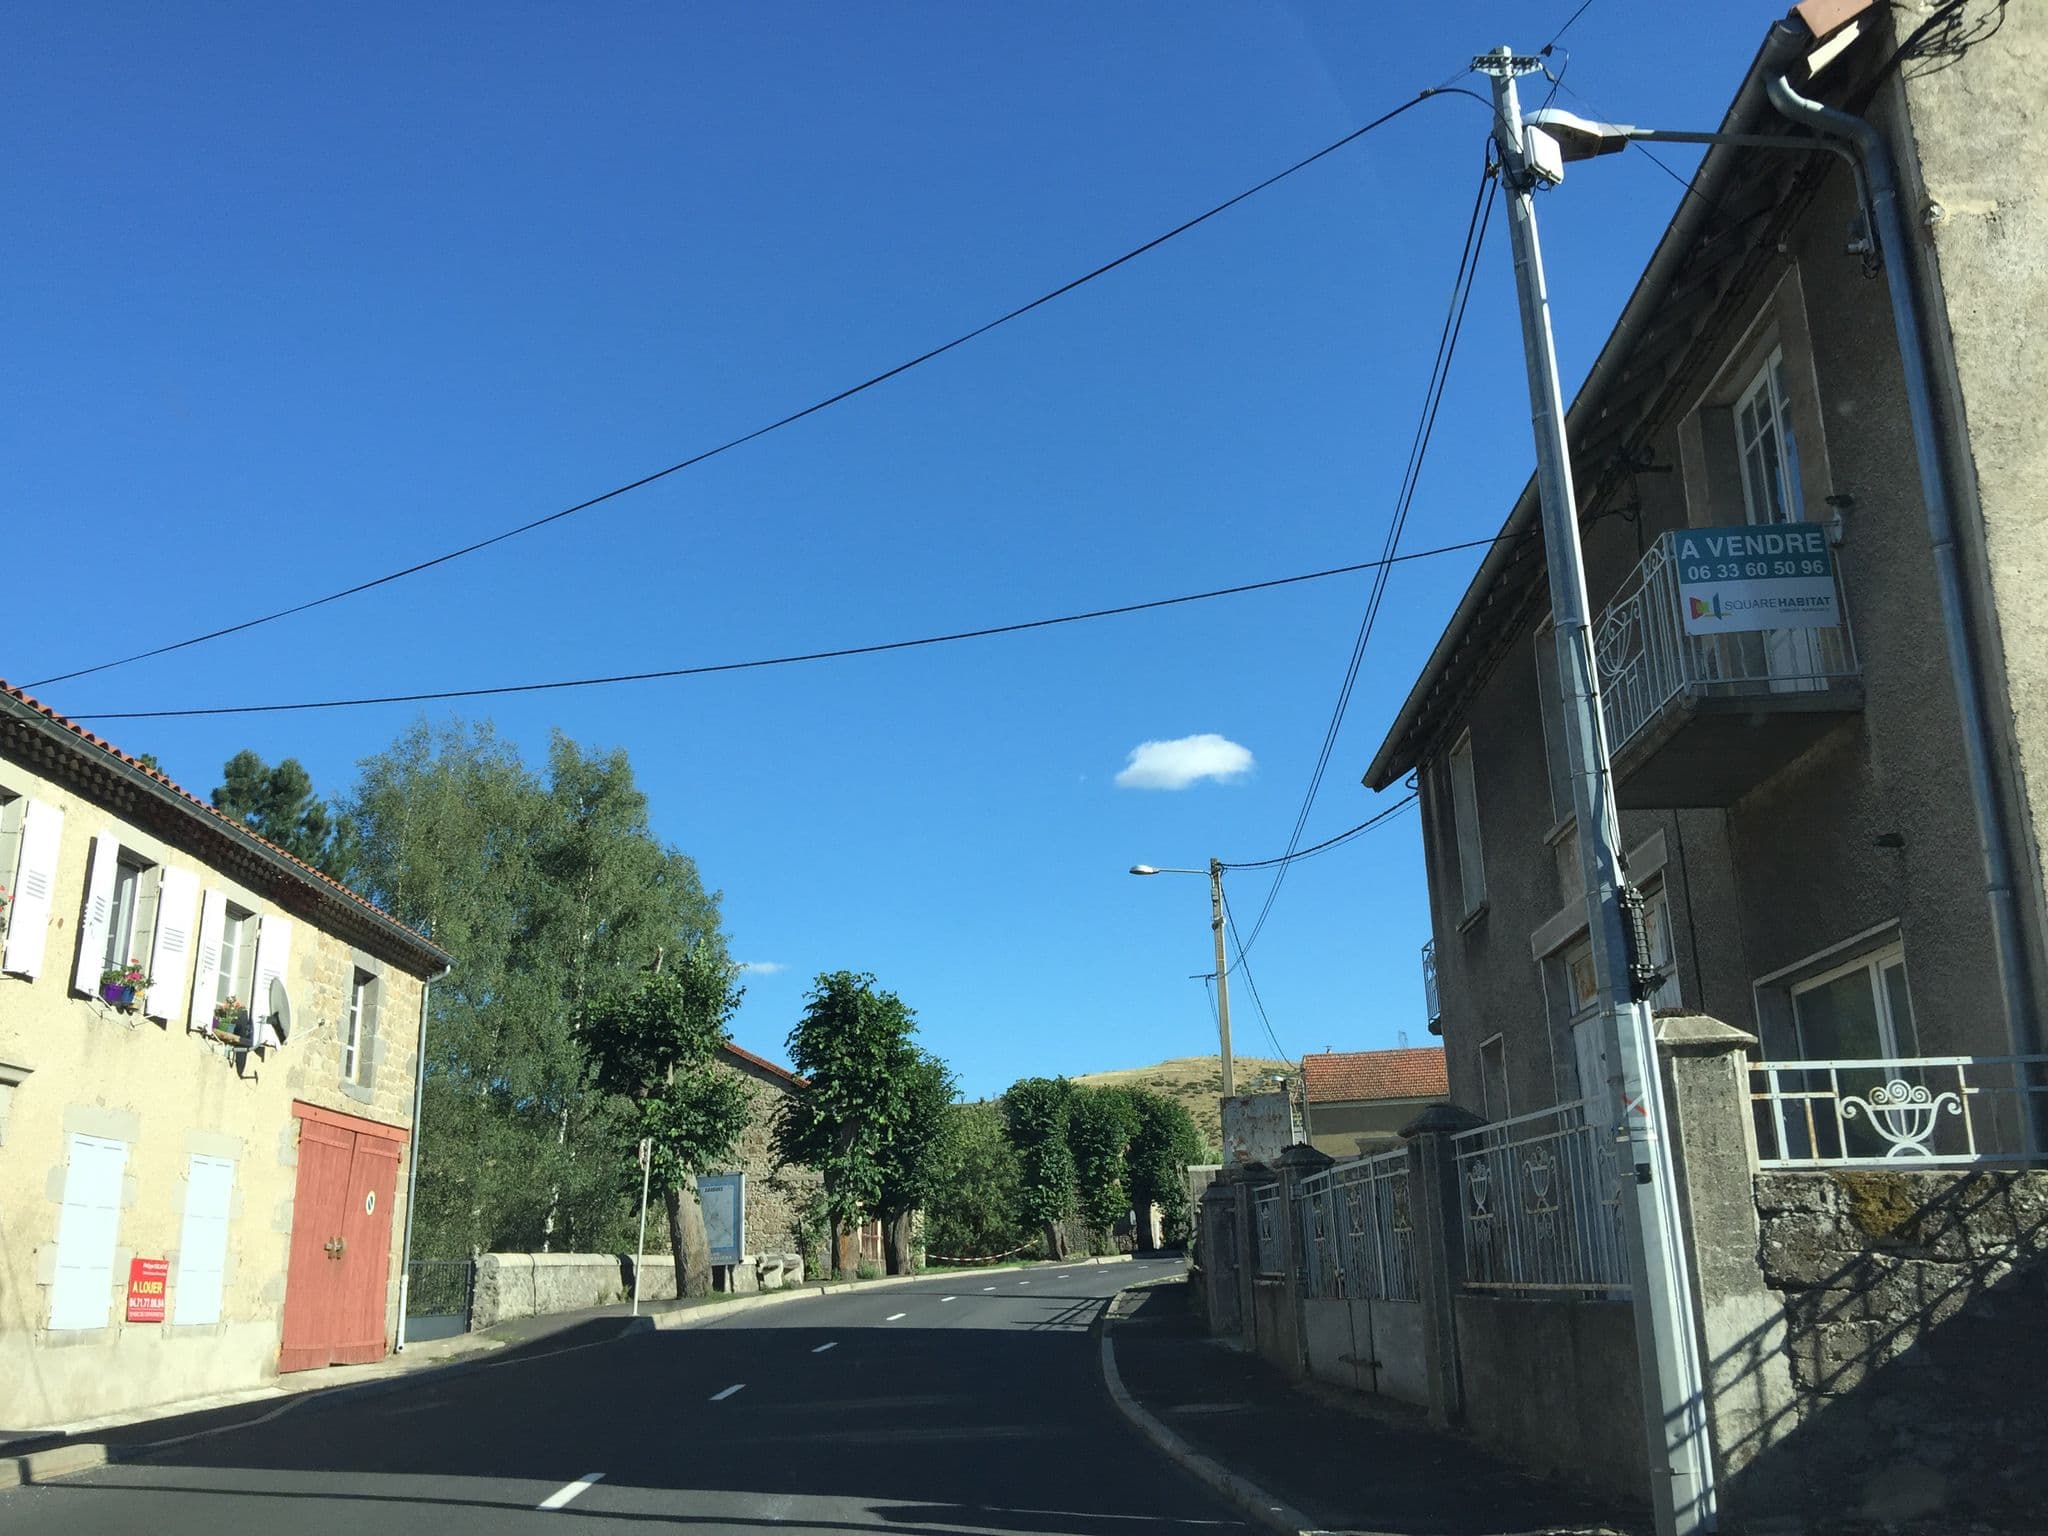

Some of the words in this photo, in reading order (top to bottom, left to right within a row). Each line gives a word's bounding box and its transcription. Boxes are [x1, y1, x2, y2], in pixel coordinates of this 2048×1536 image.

[1681, 539, 1700, 559] A
[1705, 533, 1824, 558] VENDRE
[1688, 565, 1711, 580] 06
[1717, 564, 1740, 578] 33
[1745, 562, 1768, 576] 60
[1774, 561, 1796, 575] 50
[1801, 560, 1824, 574] 96
[132, 1281, 139, 1293] A
[139, 1281, 163, 1294] LOUER
